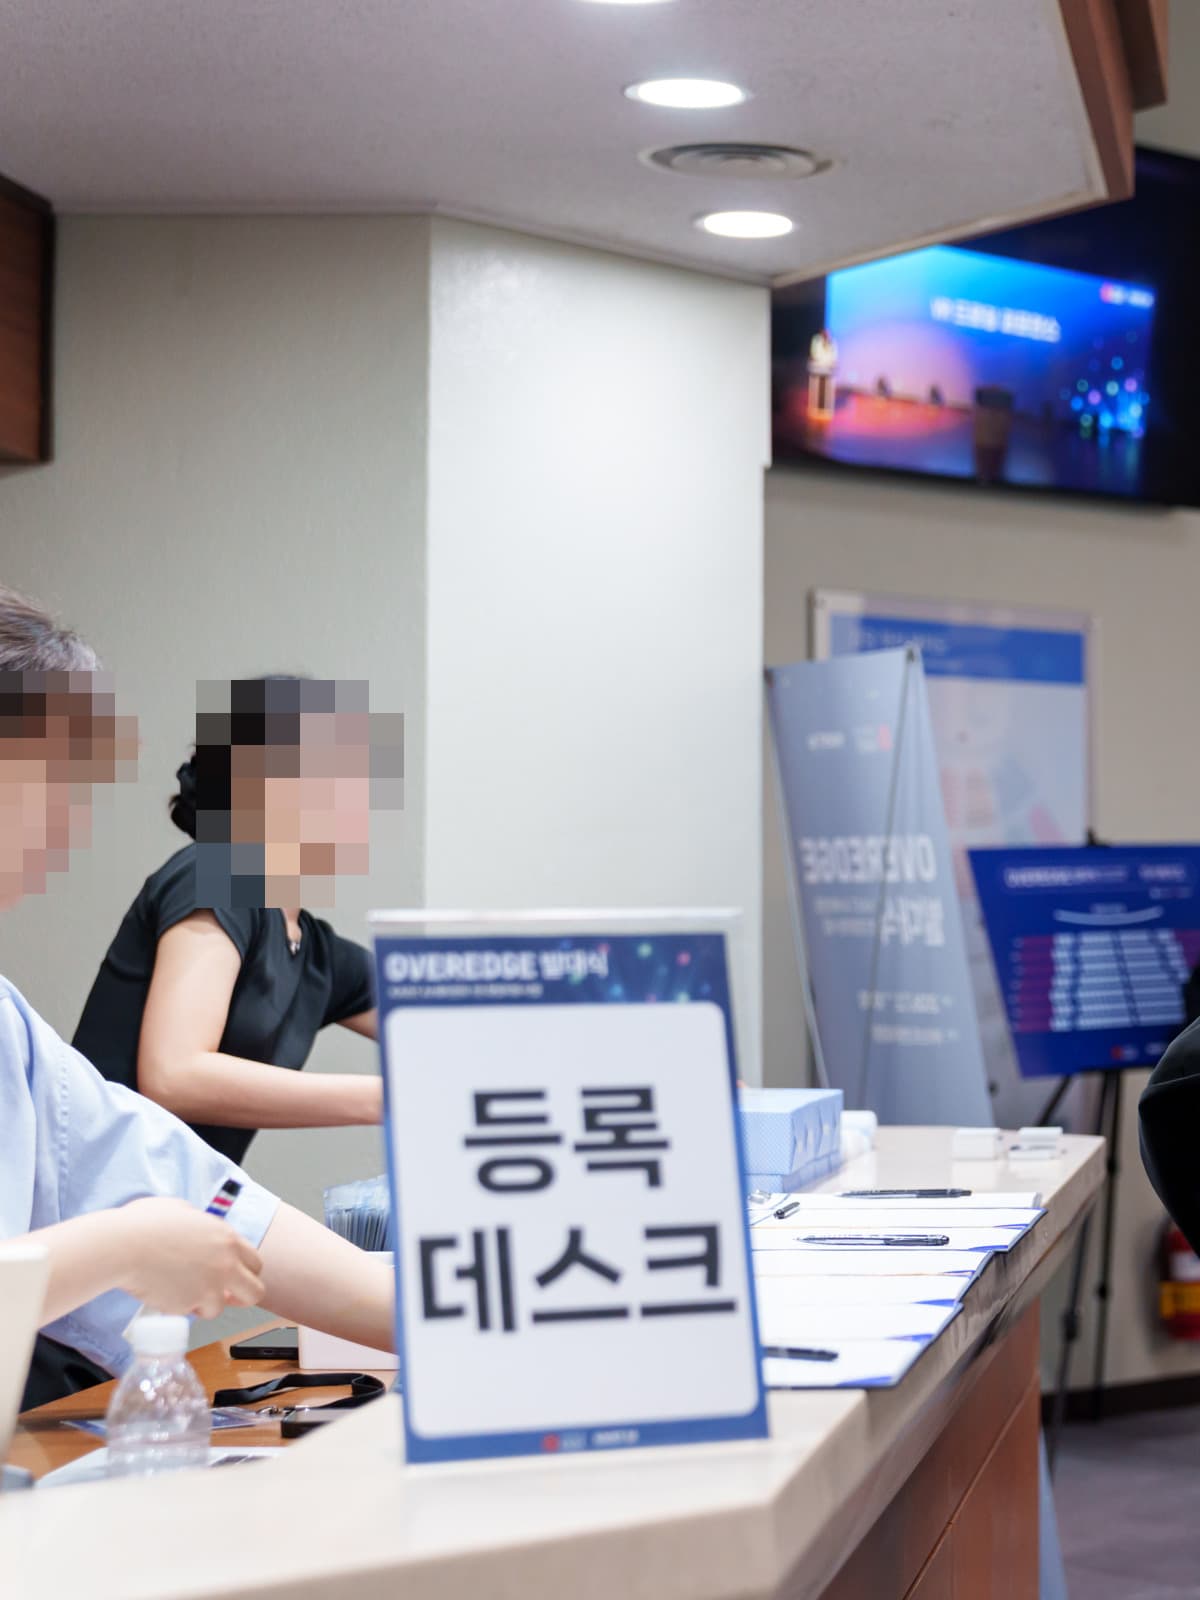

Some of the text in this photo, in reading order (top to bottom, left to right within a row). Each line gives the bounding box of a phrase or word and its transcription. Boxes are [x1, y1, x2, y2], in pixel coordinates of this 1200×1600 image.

[385, 950, 537, 983] OVEREDGE
[463, 1085, 670, 1193] 등록
[418, 1222, 737, 1334] 데스크
